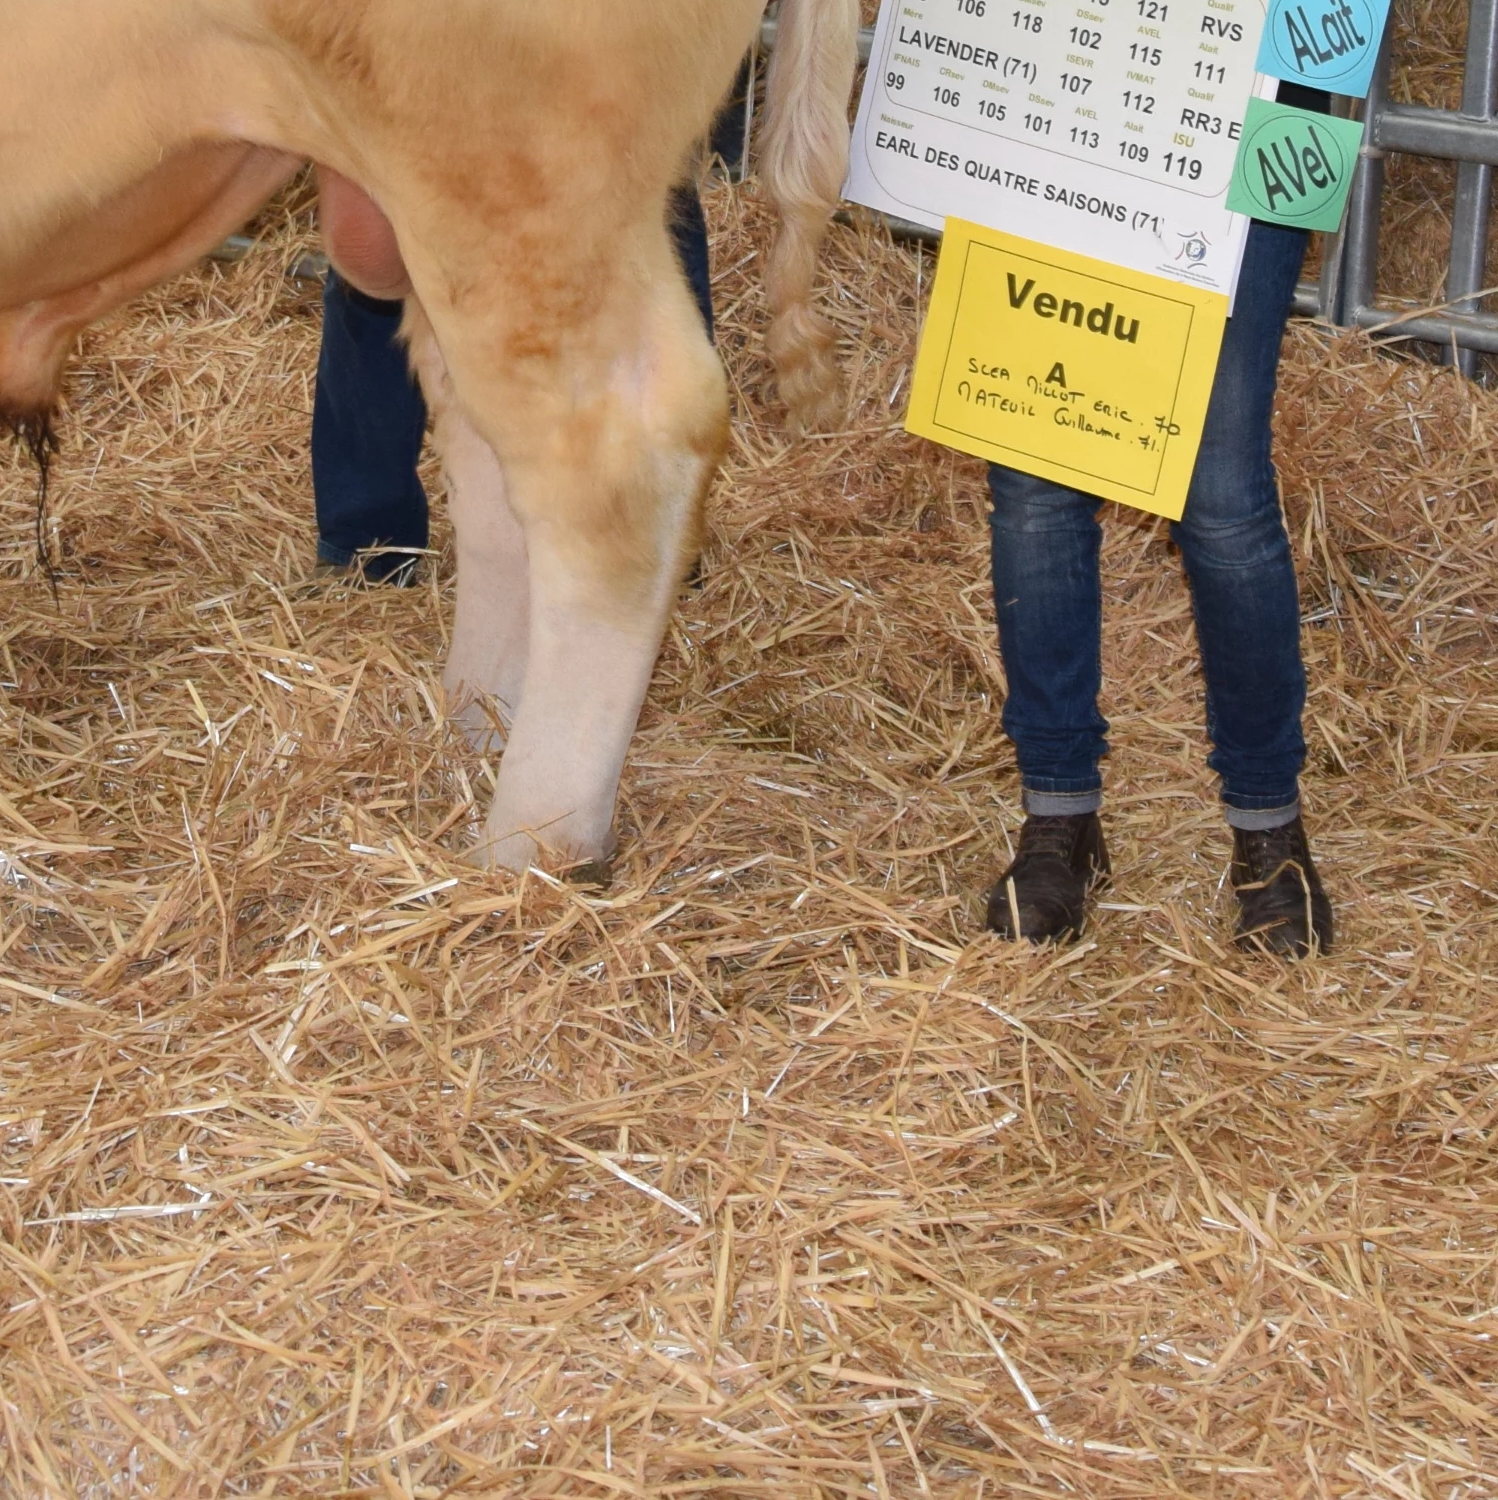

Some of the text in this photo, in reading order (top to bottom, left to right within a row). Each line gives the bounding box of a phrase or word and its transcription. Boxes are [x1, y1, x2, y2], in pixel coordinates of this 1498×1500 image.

[904, 7, 923, 19] Mère
[1077, 9, 1104, 23] DSsev
[1137, 26, 1161, 39] AVEL
[1199, 42, 1218, 54] Alait
[1137, 0, 1168, 22] 121
[1201, 16, 1243, 42] RVS
[1208, 0, 1235, 12] Qualif
[899, 26, 1037, 85] LAVENDER (71)
[1012, 11, 1043, 33] 118
[1070, 27, 1102, 50] 102
[1129, 43, 1162, 66] 115
[1195, 61, 1225, 84] 111
[894, 54, 1195, 148] IFNAIS CRsev DMsev DSsev AVEL Alait ISU
[1066, 54, 1215, 102] ISEVR IVMAT Qualif
[881, 114, 914, 130] Naisseur
[886, 72, 1202, 180] 99 106 105 101 113 109 119
[1060, 73, 1242, 140] 107 112 RR3 E
[875, 132, 920, 160] EARL
[925, 147, 959, 171] DES
[965, 160, 1040, 196] QUATRE
[1043, 184, 1127, 223] SAISONS
[1257, 125, 1336, 211] AVel
[1007, 272, 1140, 344] Vendu
[969, 358, 1010, 380] SCEA
[1045, 362, 1067, 388] A
